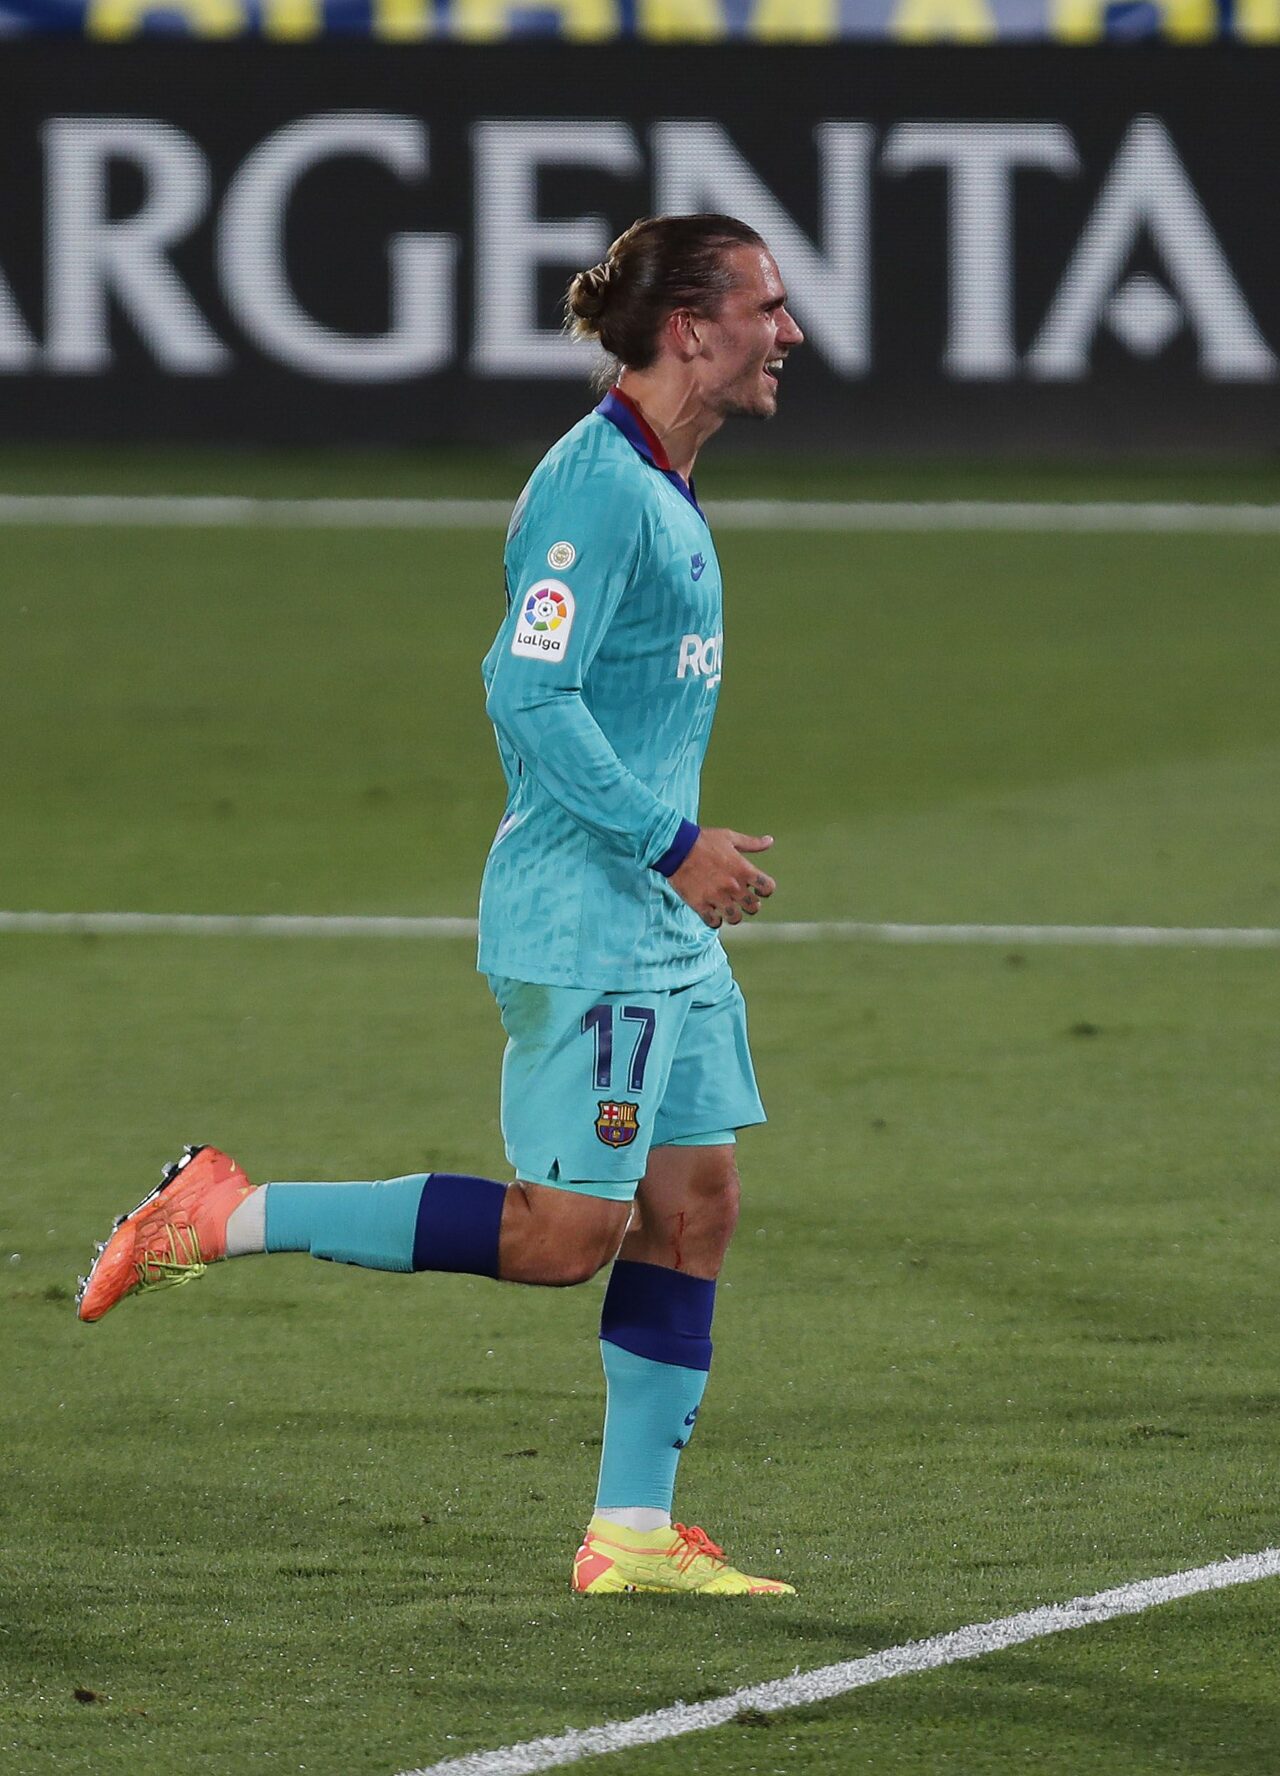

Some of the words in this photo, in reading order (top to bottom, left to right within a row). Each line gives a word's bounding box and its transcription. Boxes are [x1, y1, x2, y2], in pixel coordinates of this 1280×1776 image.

[0, 110, 1280, 381] RGENTA
[517, 631, 561, 651] LaLiga
[580, 1003, 657, 1094] 17
